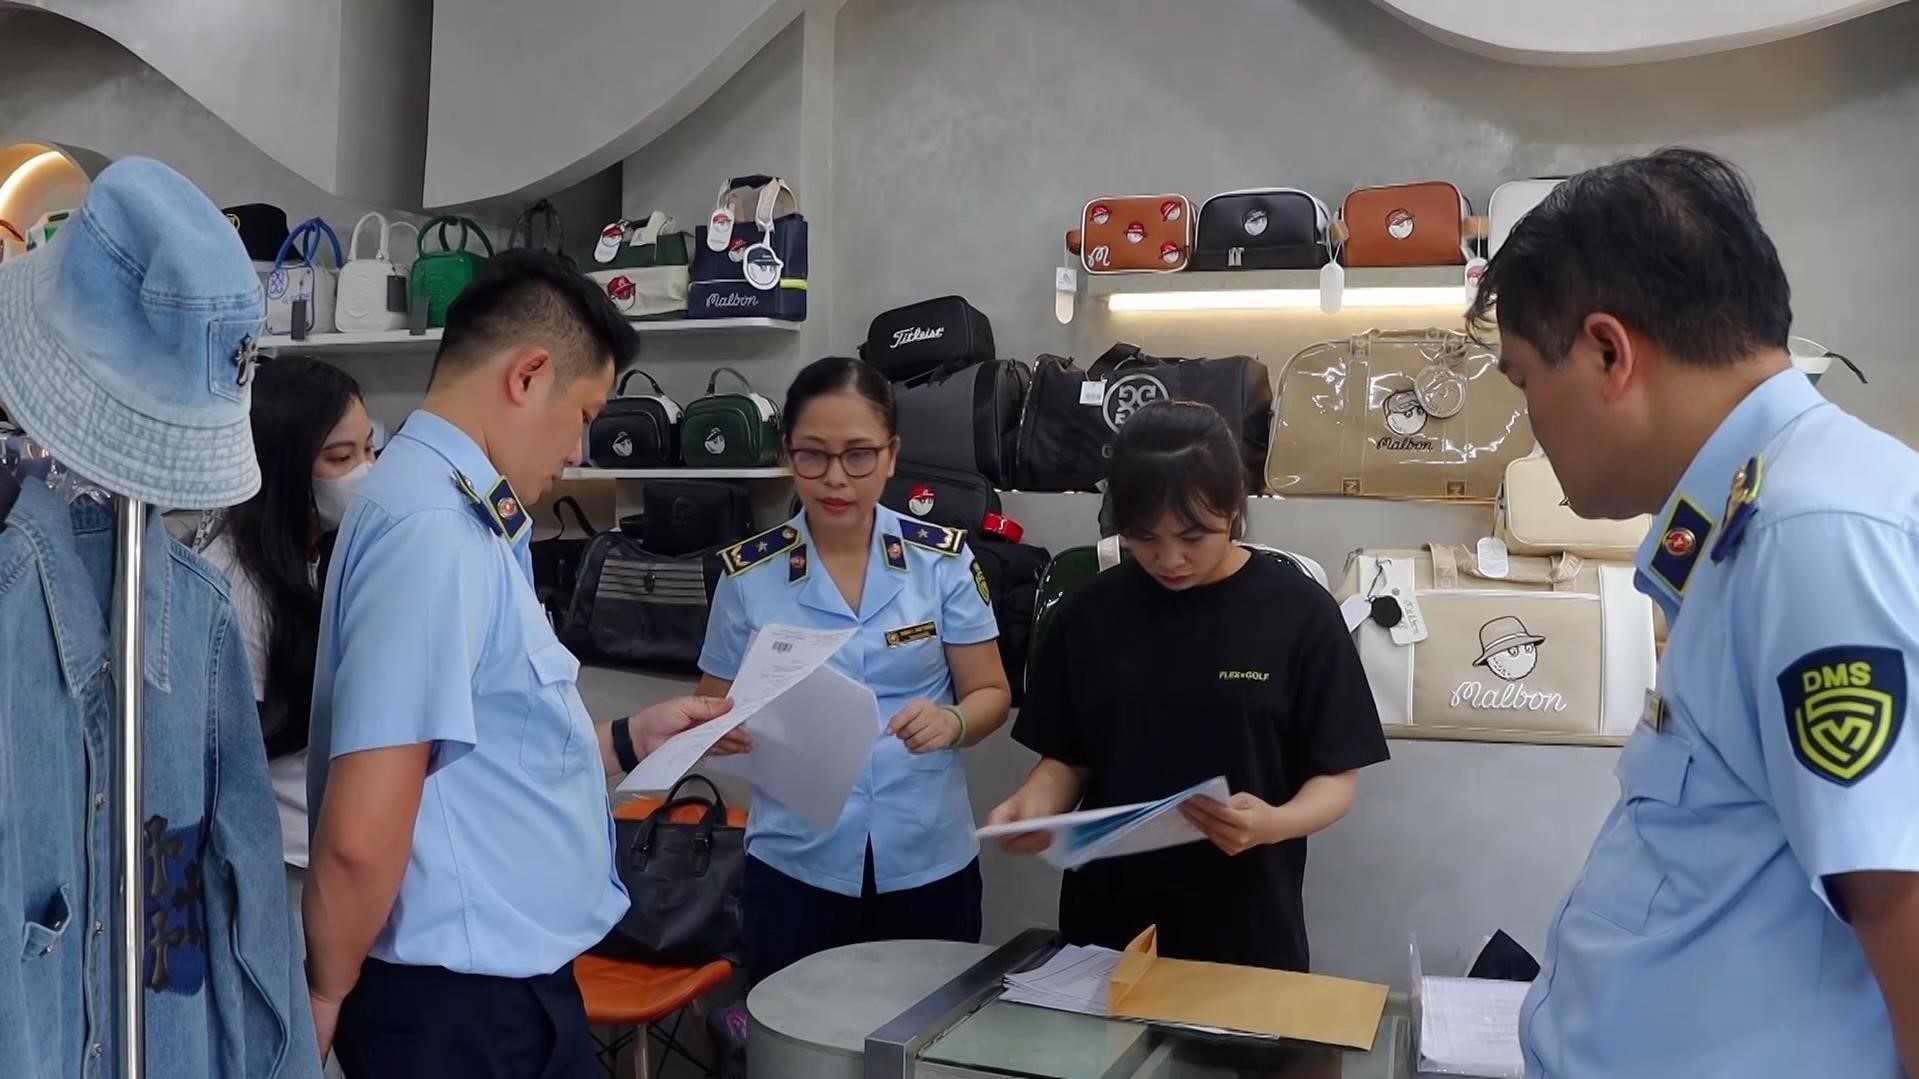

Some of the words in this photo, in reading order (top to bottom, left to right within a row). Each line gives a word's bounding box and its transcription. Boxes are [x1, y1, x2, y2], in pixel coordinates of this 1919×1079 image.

[705, 292, 759, 308] Malbon
[889, 326, 945, 349] Titleist
[1376, 437, 1434, 451] Malbon
[1245, 670, 1271, 682] GOLF
[1802, 660, 1872, 694] DMS
[1449, 681, 1568, 713] Malbon
